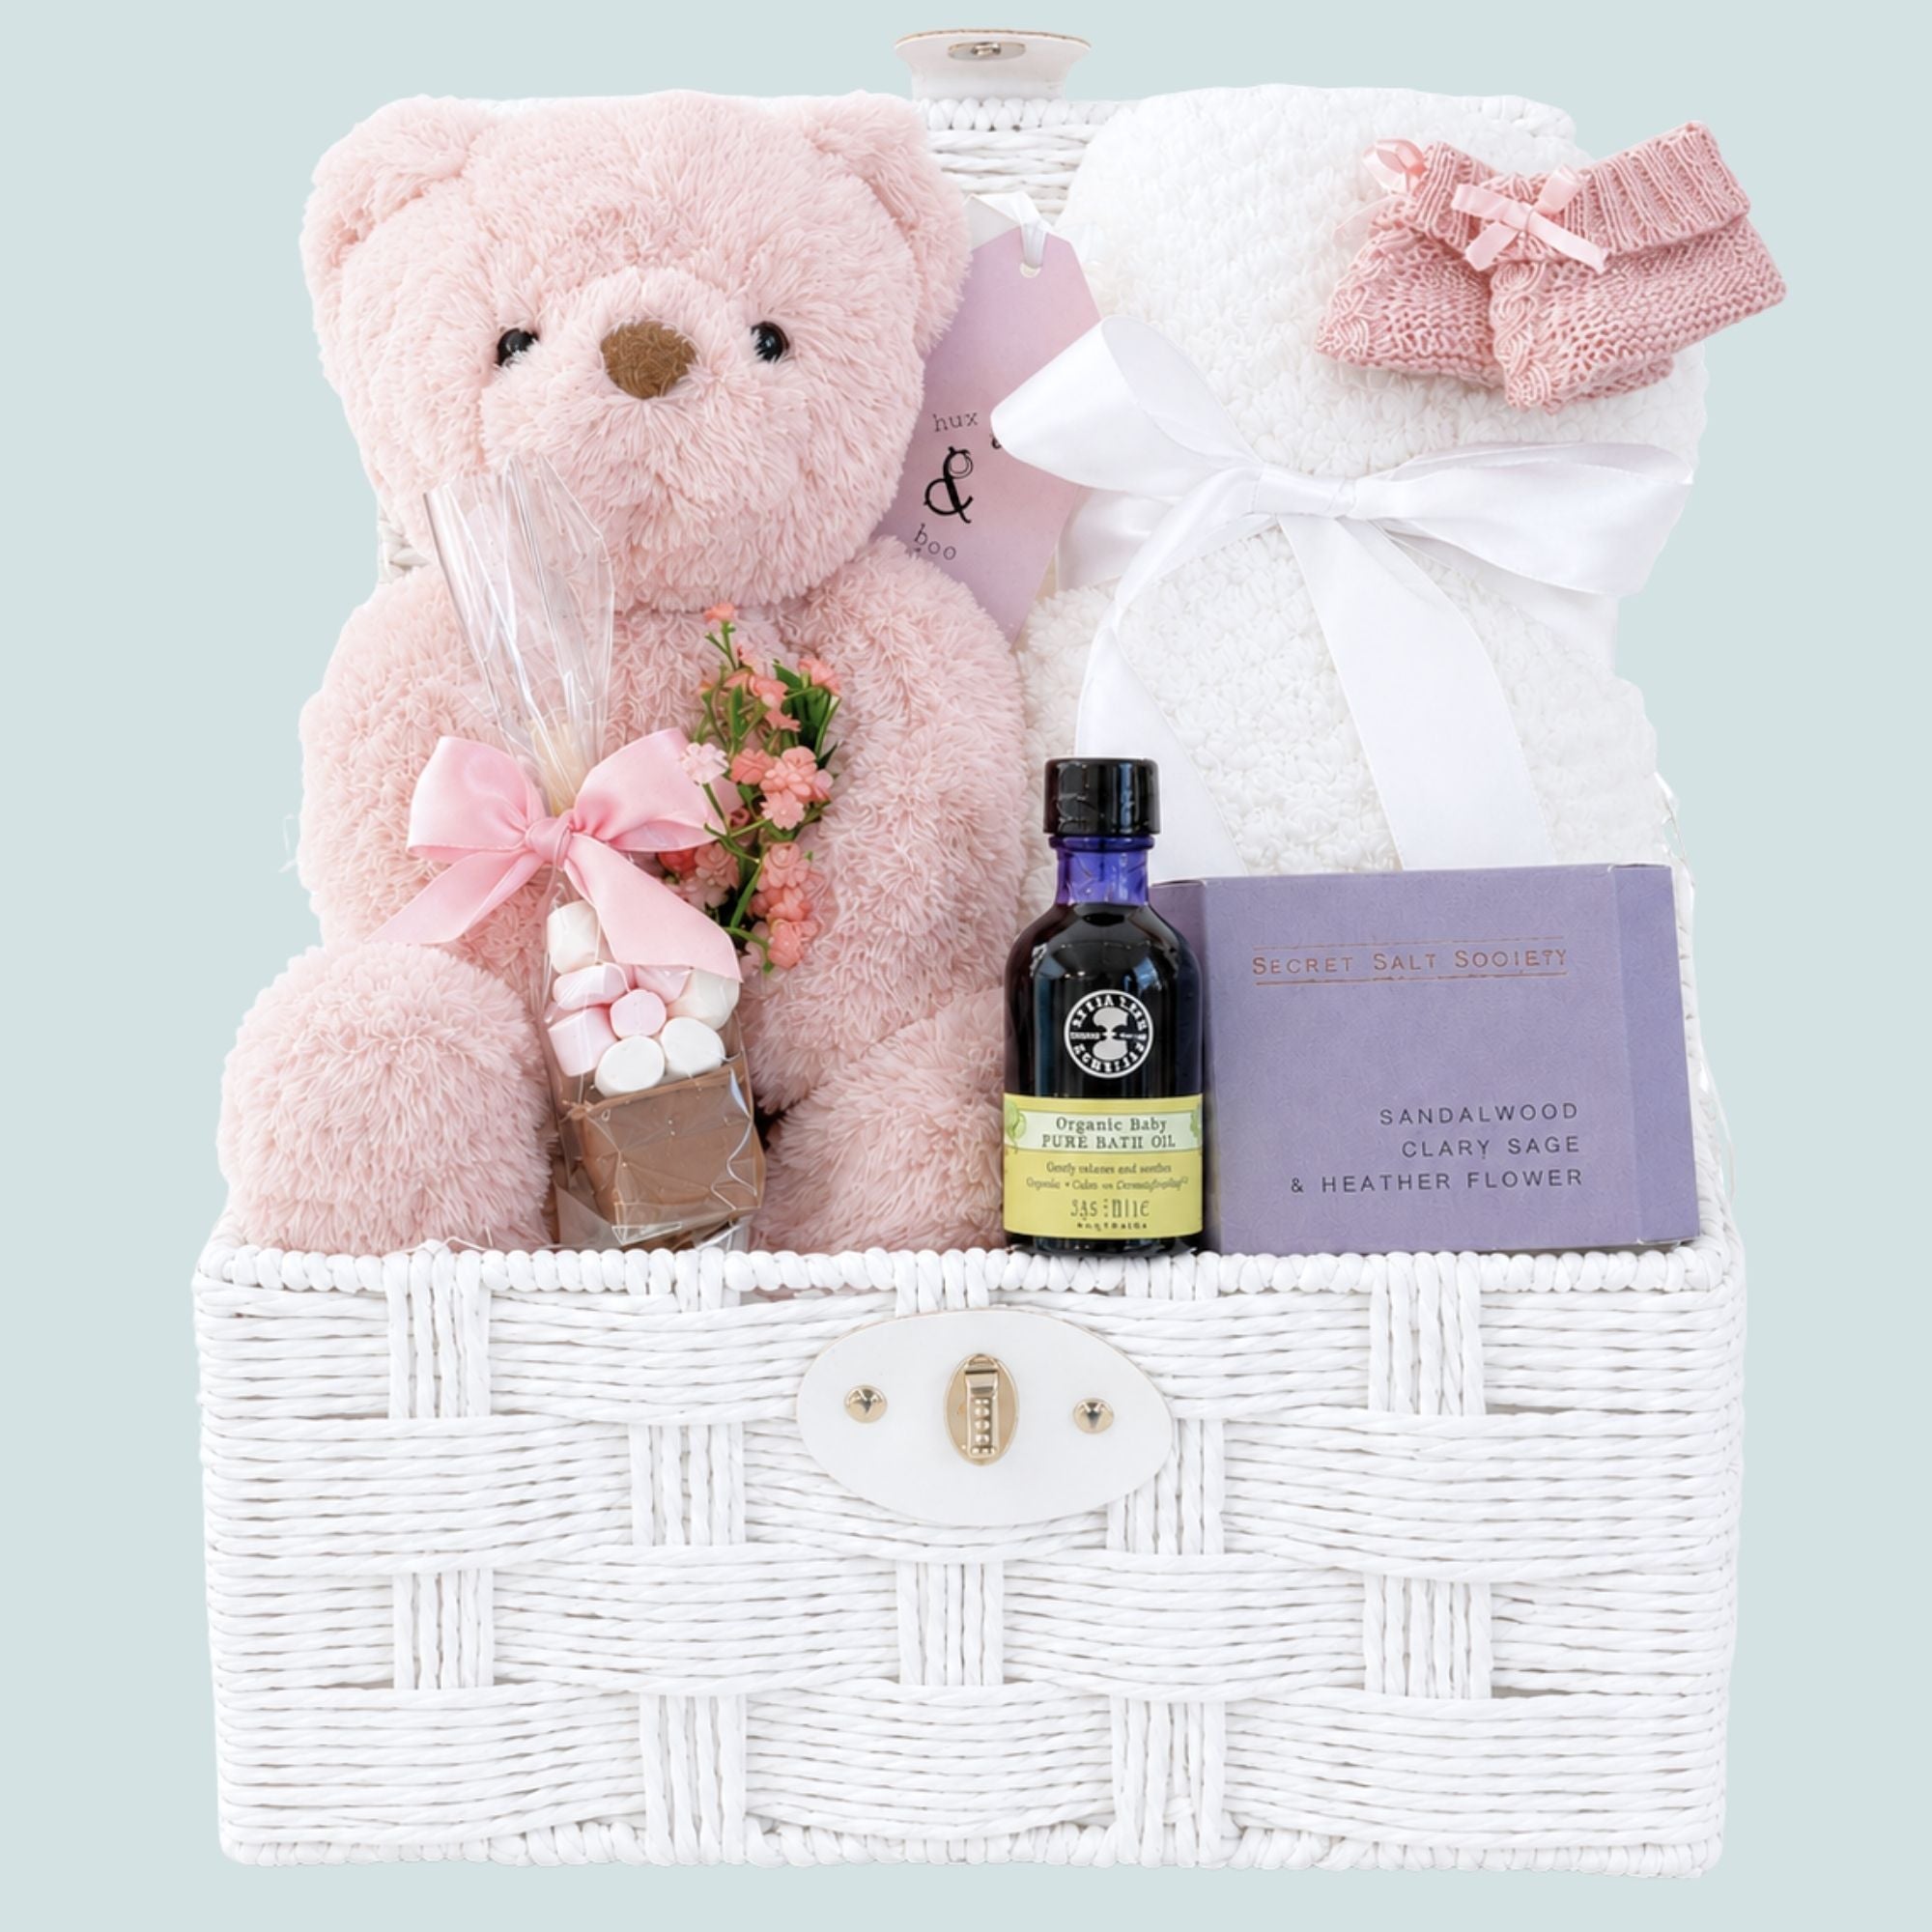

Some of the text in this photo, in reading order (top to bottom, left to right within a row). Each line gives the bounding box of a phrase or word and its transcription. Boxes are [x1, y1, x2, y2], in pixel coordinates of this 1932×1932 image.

[933, 412, 978, 432] hux
[923, 446, 974, 524] &
[914, 523, 956, 560] boo
[1252, 956, 1353, 975] SECRET
[1373, 952, 1435, 971] SALT
[1056, 1116, 1167, 1134] Organic Baby
[1379, 1102, 1577, 1125] SANDALWOOD
[1041, 1134, 1088, 1149] PURE
[1402, 1136, 1579, 1158] CLARY SAGE
[1291, 1169, 1582, 1193] & HEATHER FLOWER
